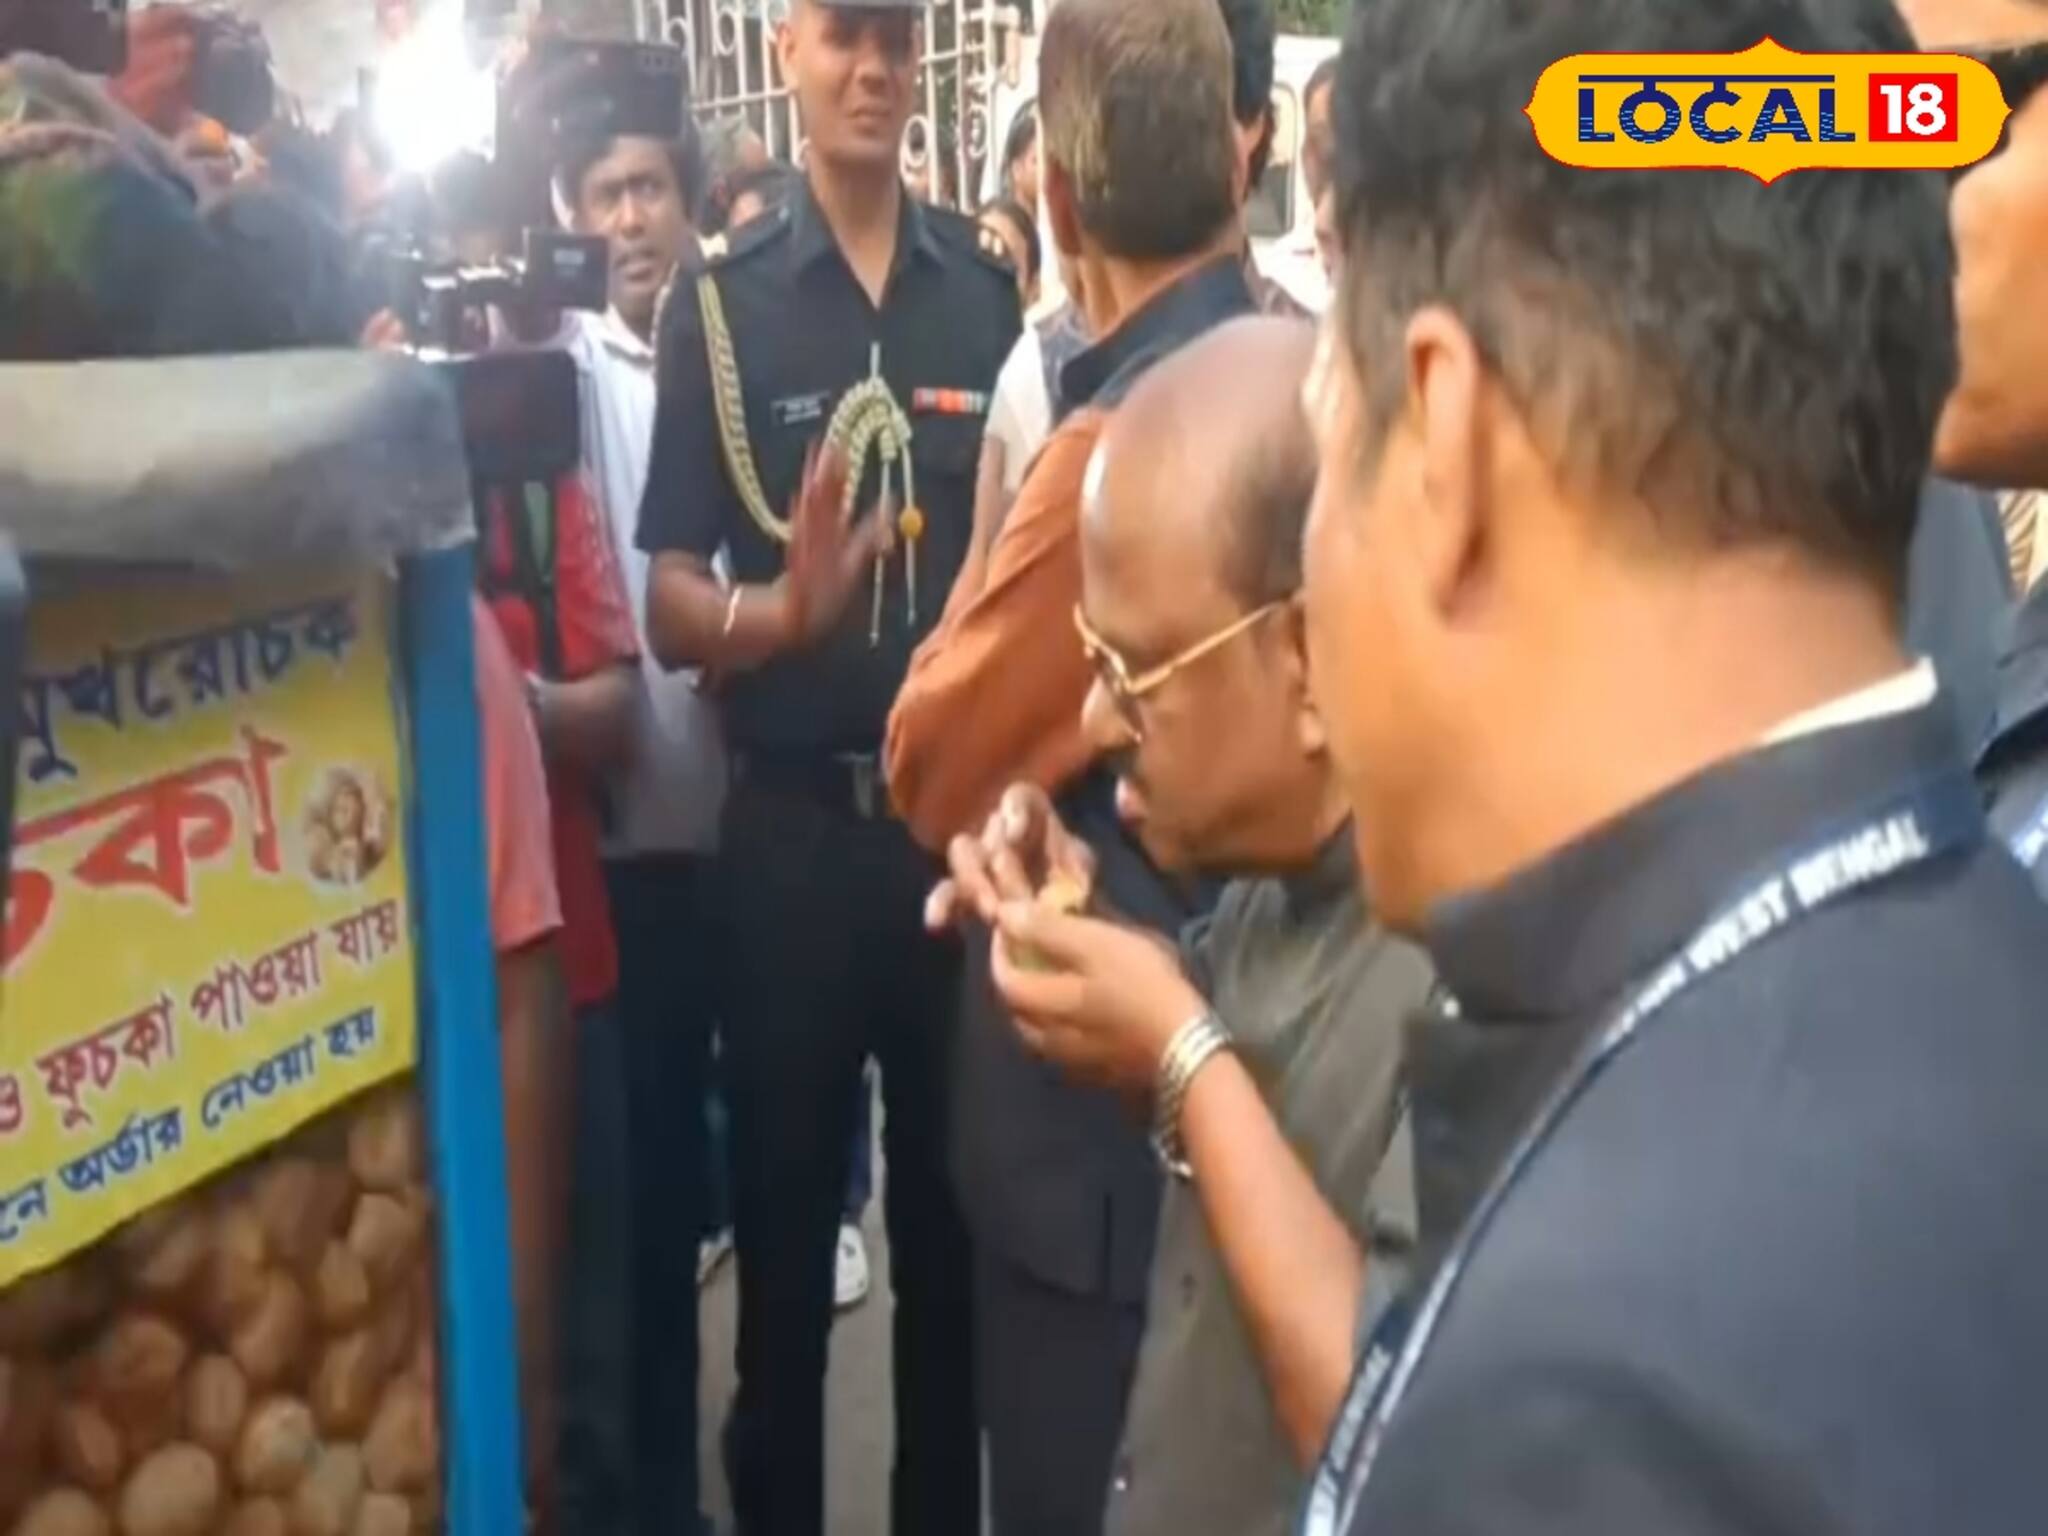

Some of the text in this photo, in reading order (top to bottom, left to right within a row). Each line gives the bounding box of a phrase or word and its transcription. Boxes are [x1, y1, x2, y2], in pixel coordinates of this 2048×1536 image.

[36, 990, 174, 1128] ফুচকা
[190, 930, 320, 1031] পাওয়া
[330, 898, 397, 963] যায়
[58, 1106, 181, 1192] অর্ডার
[201, 1035, 315, 1128] নেওয়া
[323, 1006, 374, 1056] হয়
